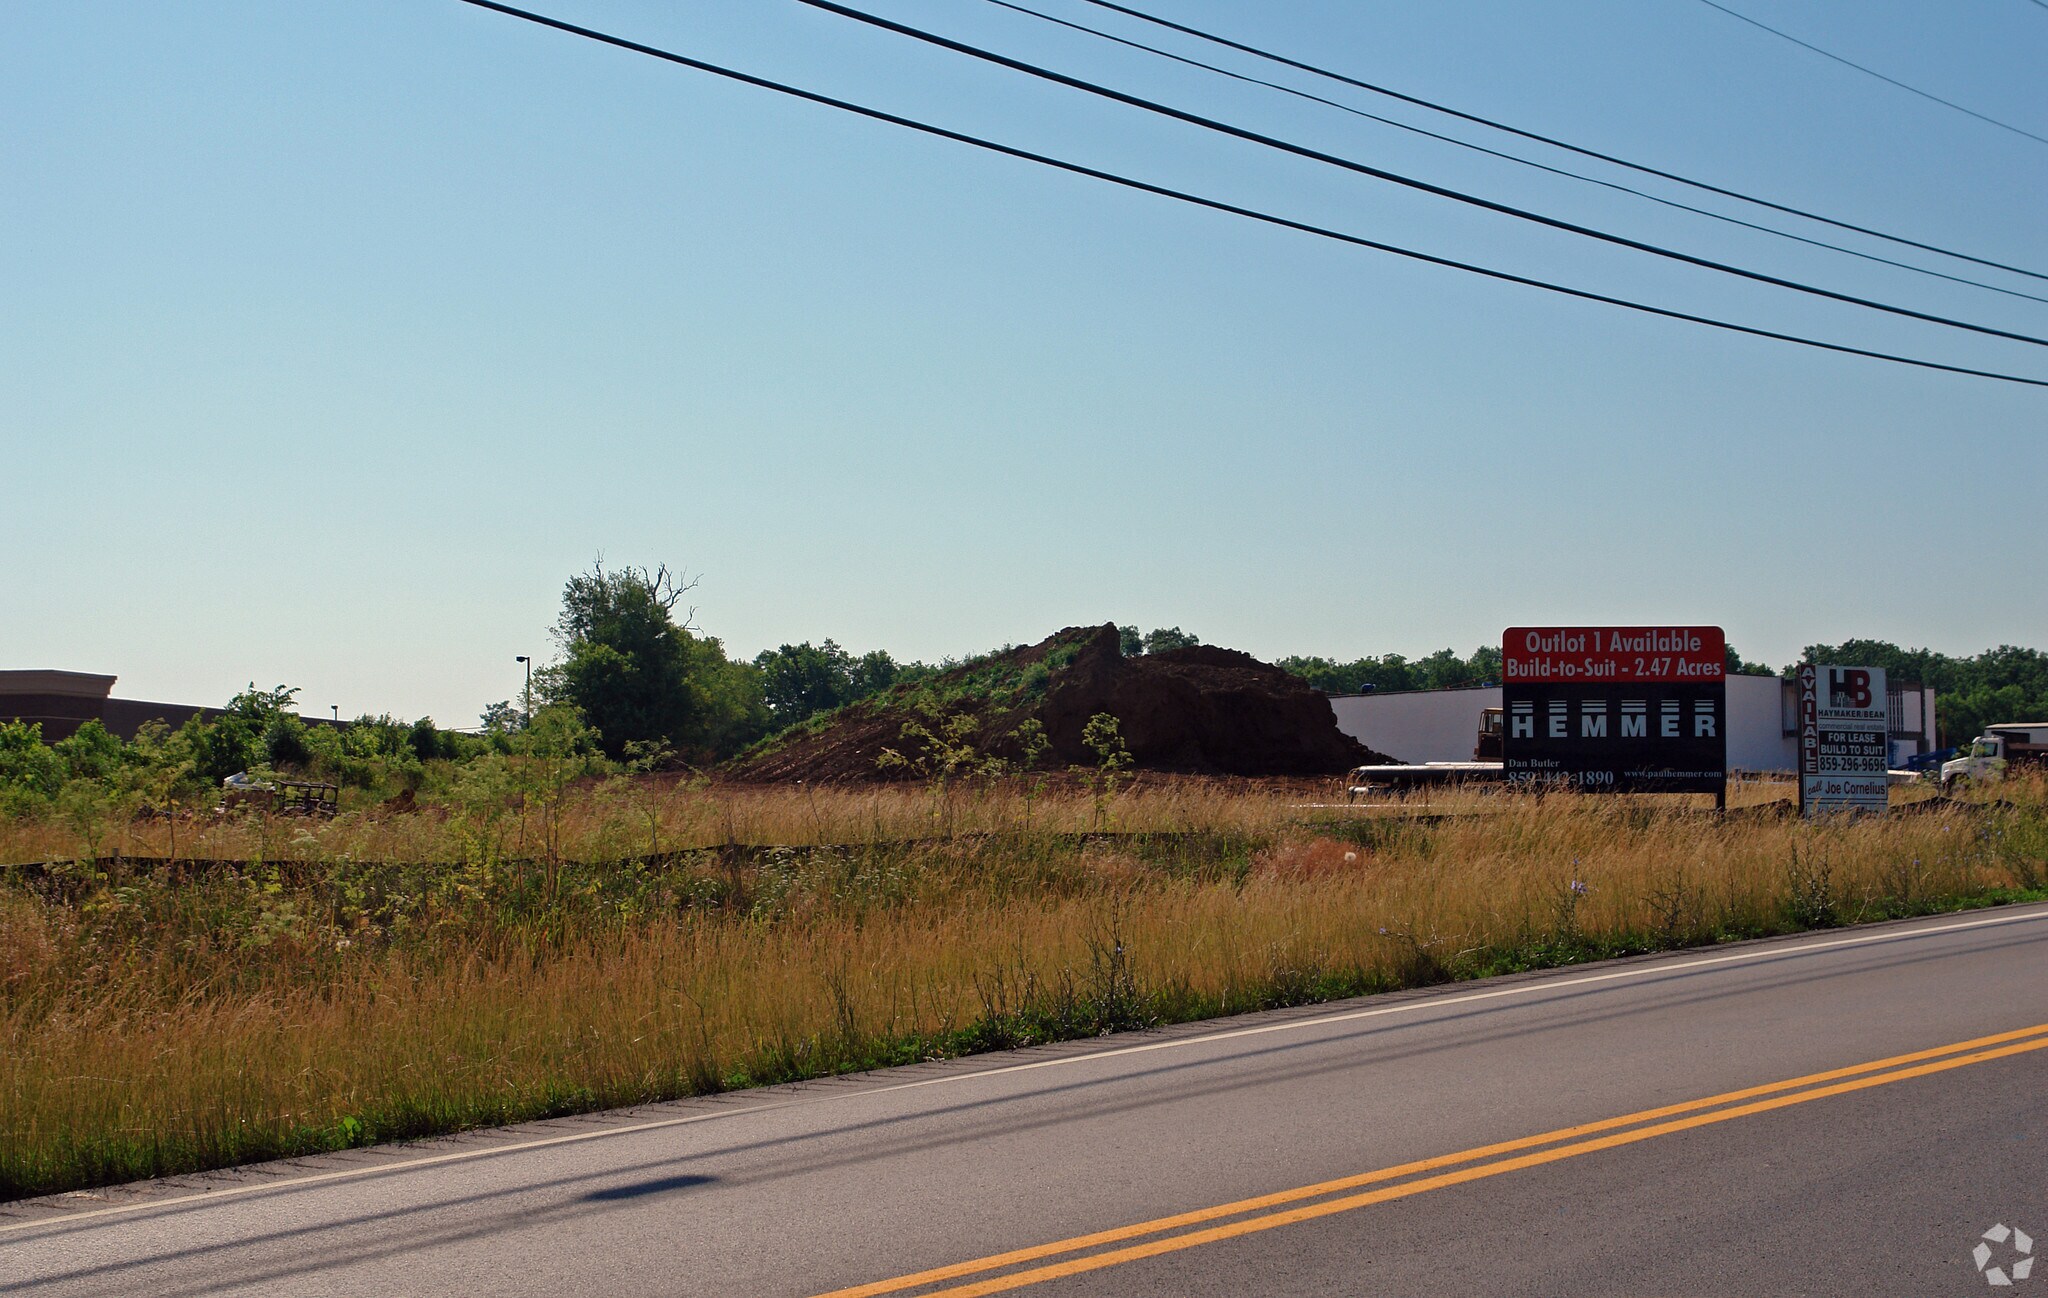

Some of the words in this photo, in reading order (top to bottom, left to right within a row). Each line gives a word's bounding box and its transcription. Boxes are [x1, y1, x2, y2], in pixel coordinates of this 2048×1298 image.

[1526, 631, 1586, 653] Outlot
[1593, 631, 1601, 652] 1
[1609, 630, 1702, 652] Available
[1507, 658, 1616, 677] Build-to-Suit
[1634, 658, 1671, 676] 2.47
[1676, 658, 1721, 676] Acres
[1829, 668, 1873, 709] HB
[1511, 714, 1716, 739] HEMMER
[1801, 667, 1818, 773] AVAILABLE
[1828, 732, 1847, 742] FOR
[1848, 733, 1876, 743] LEASE
[1820, 744, 1847, 754] BUILD
[1849, 745, 1861, 755] TO
[1863, 745, 1885, 756] SUIT
[1508, 759, 1528, 768] Dan
[1530, 759, 1560, 768] Butler
[1819, 756, 1886, 772] 859-296-9696
[1623, 769, 1723, 780] www.paulhemmercom
[1807, 780, 1823, 796] call
[1825, 782, 1841, 795] Joe
[1843, 782, 1886, 796] Cornelius
